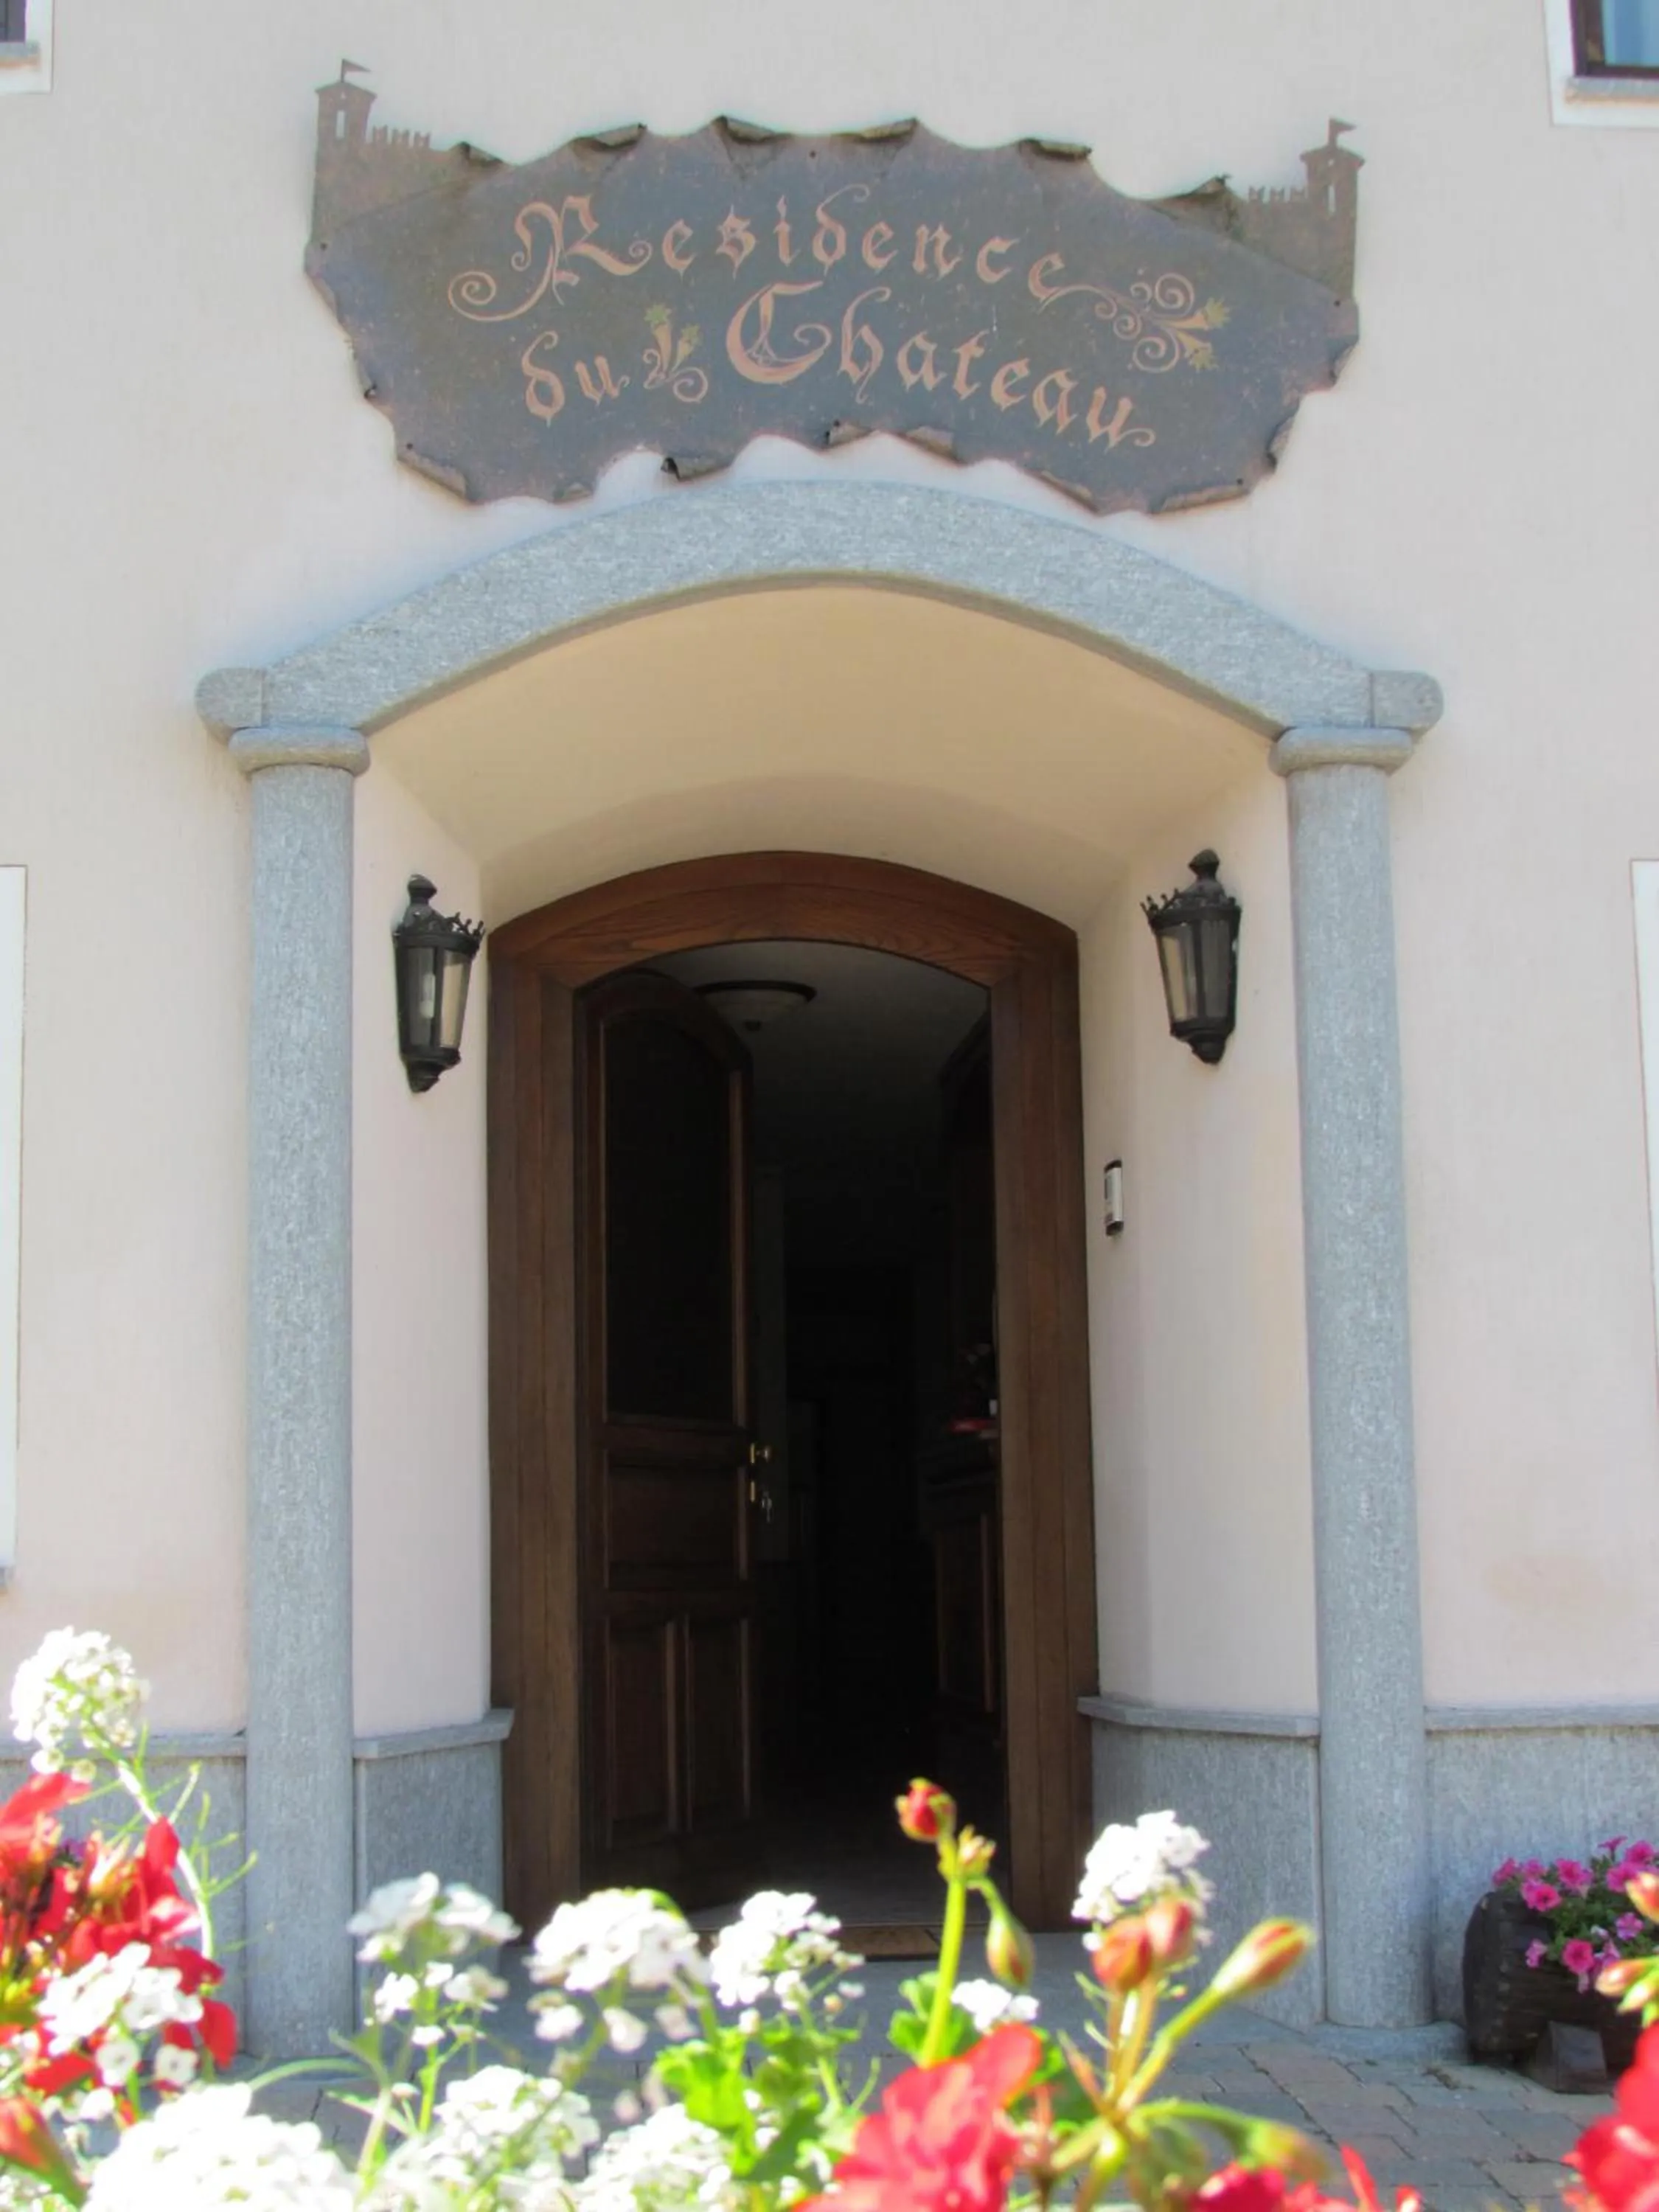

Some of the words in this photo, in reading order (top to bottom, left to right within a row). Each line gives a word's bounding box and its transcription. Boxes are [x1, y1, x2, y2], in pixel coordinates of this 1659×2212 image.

[448, 183, 1091, 322] Residence
[521, 330, 630, 428] du
[726, 280, 1156, 449] Chateau
